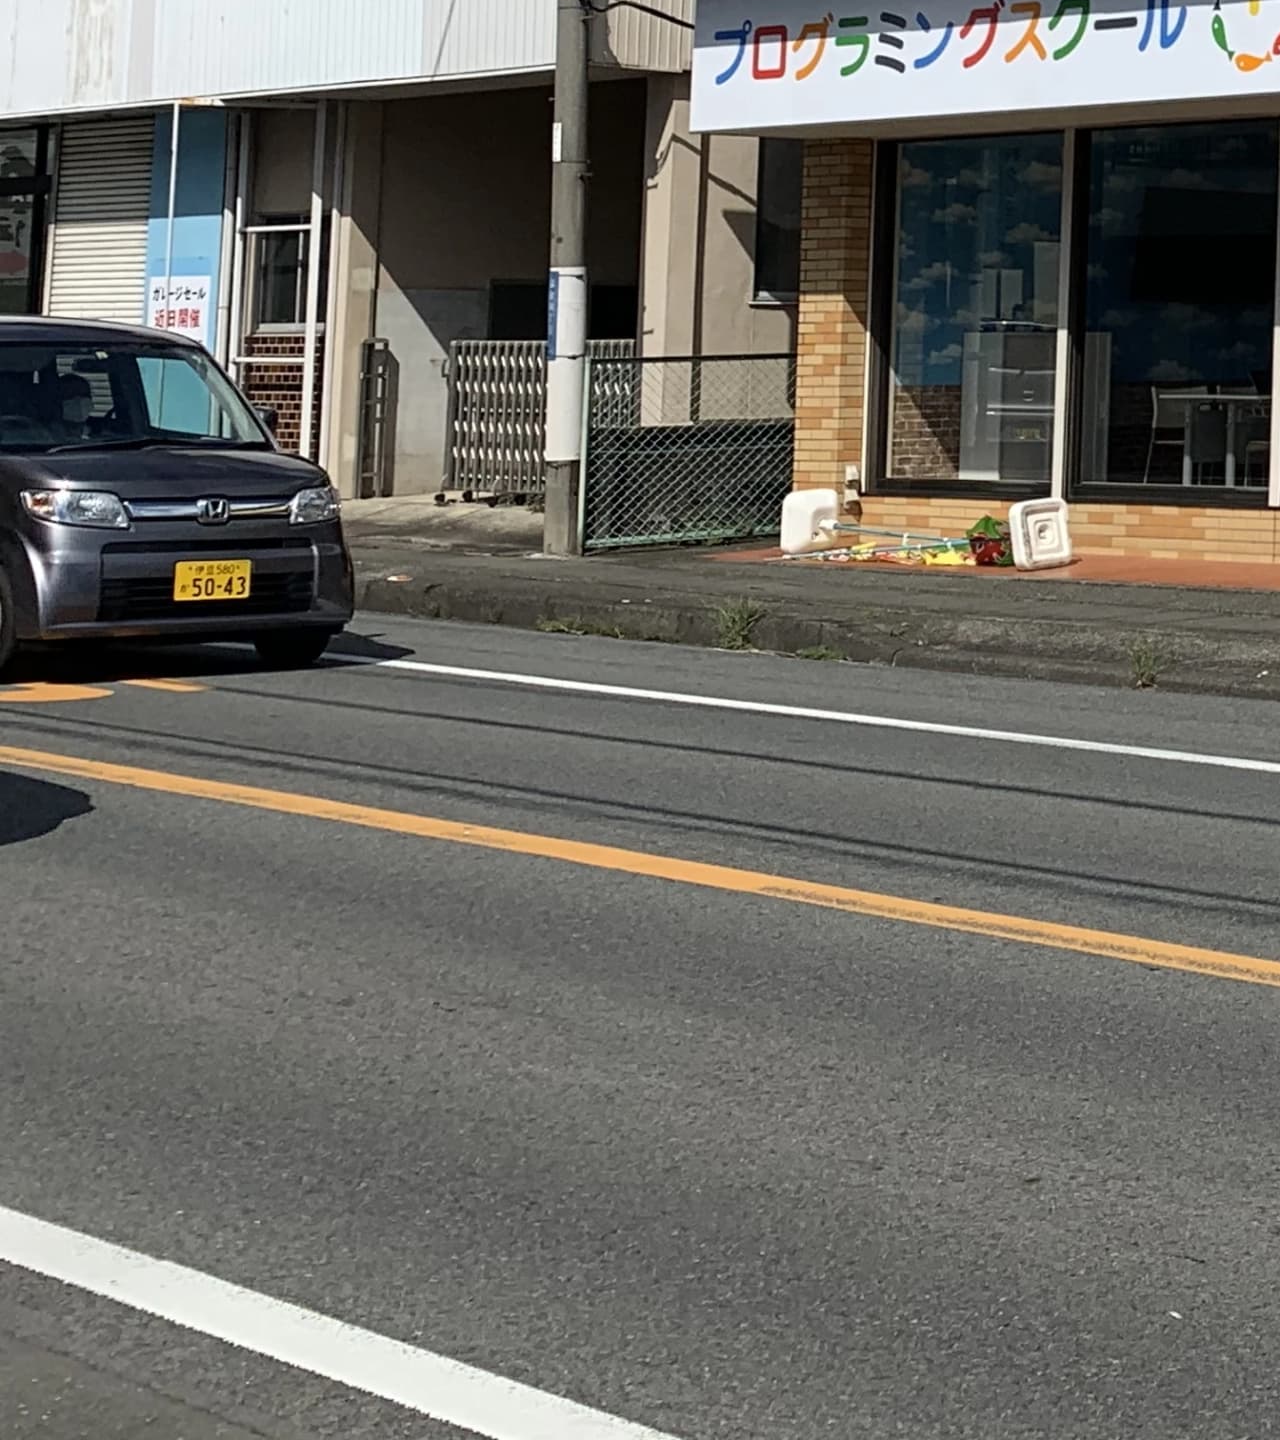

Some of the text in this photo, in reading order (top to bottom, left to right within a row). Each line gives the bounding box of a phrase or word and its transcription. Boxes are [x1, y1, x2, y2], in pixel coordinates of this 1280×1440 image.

[152, 286, 206, 302] ガレージセール
[154, 308, 201, 329] 近日開催
[192, 576, 246, 597] 50-43
